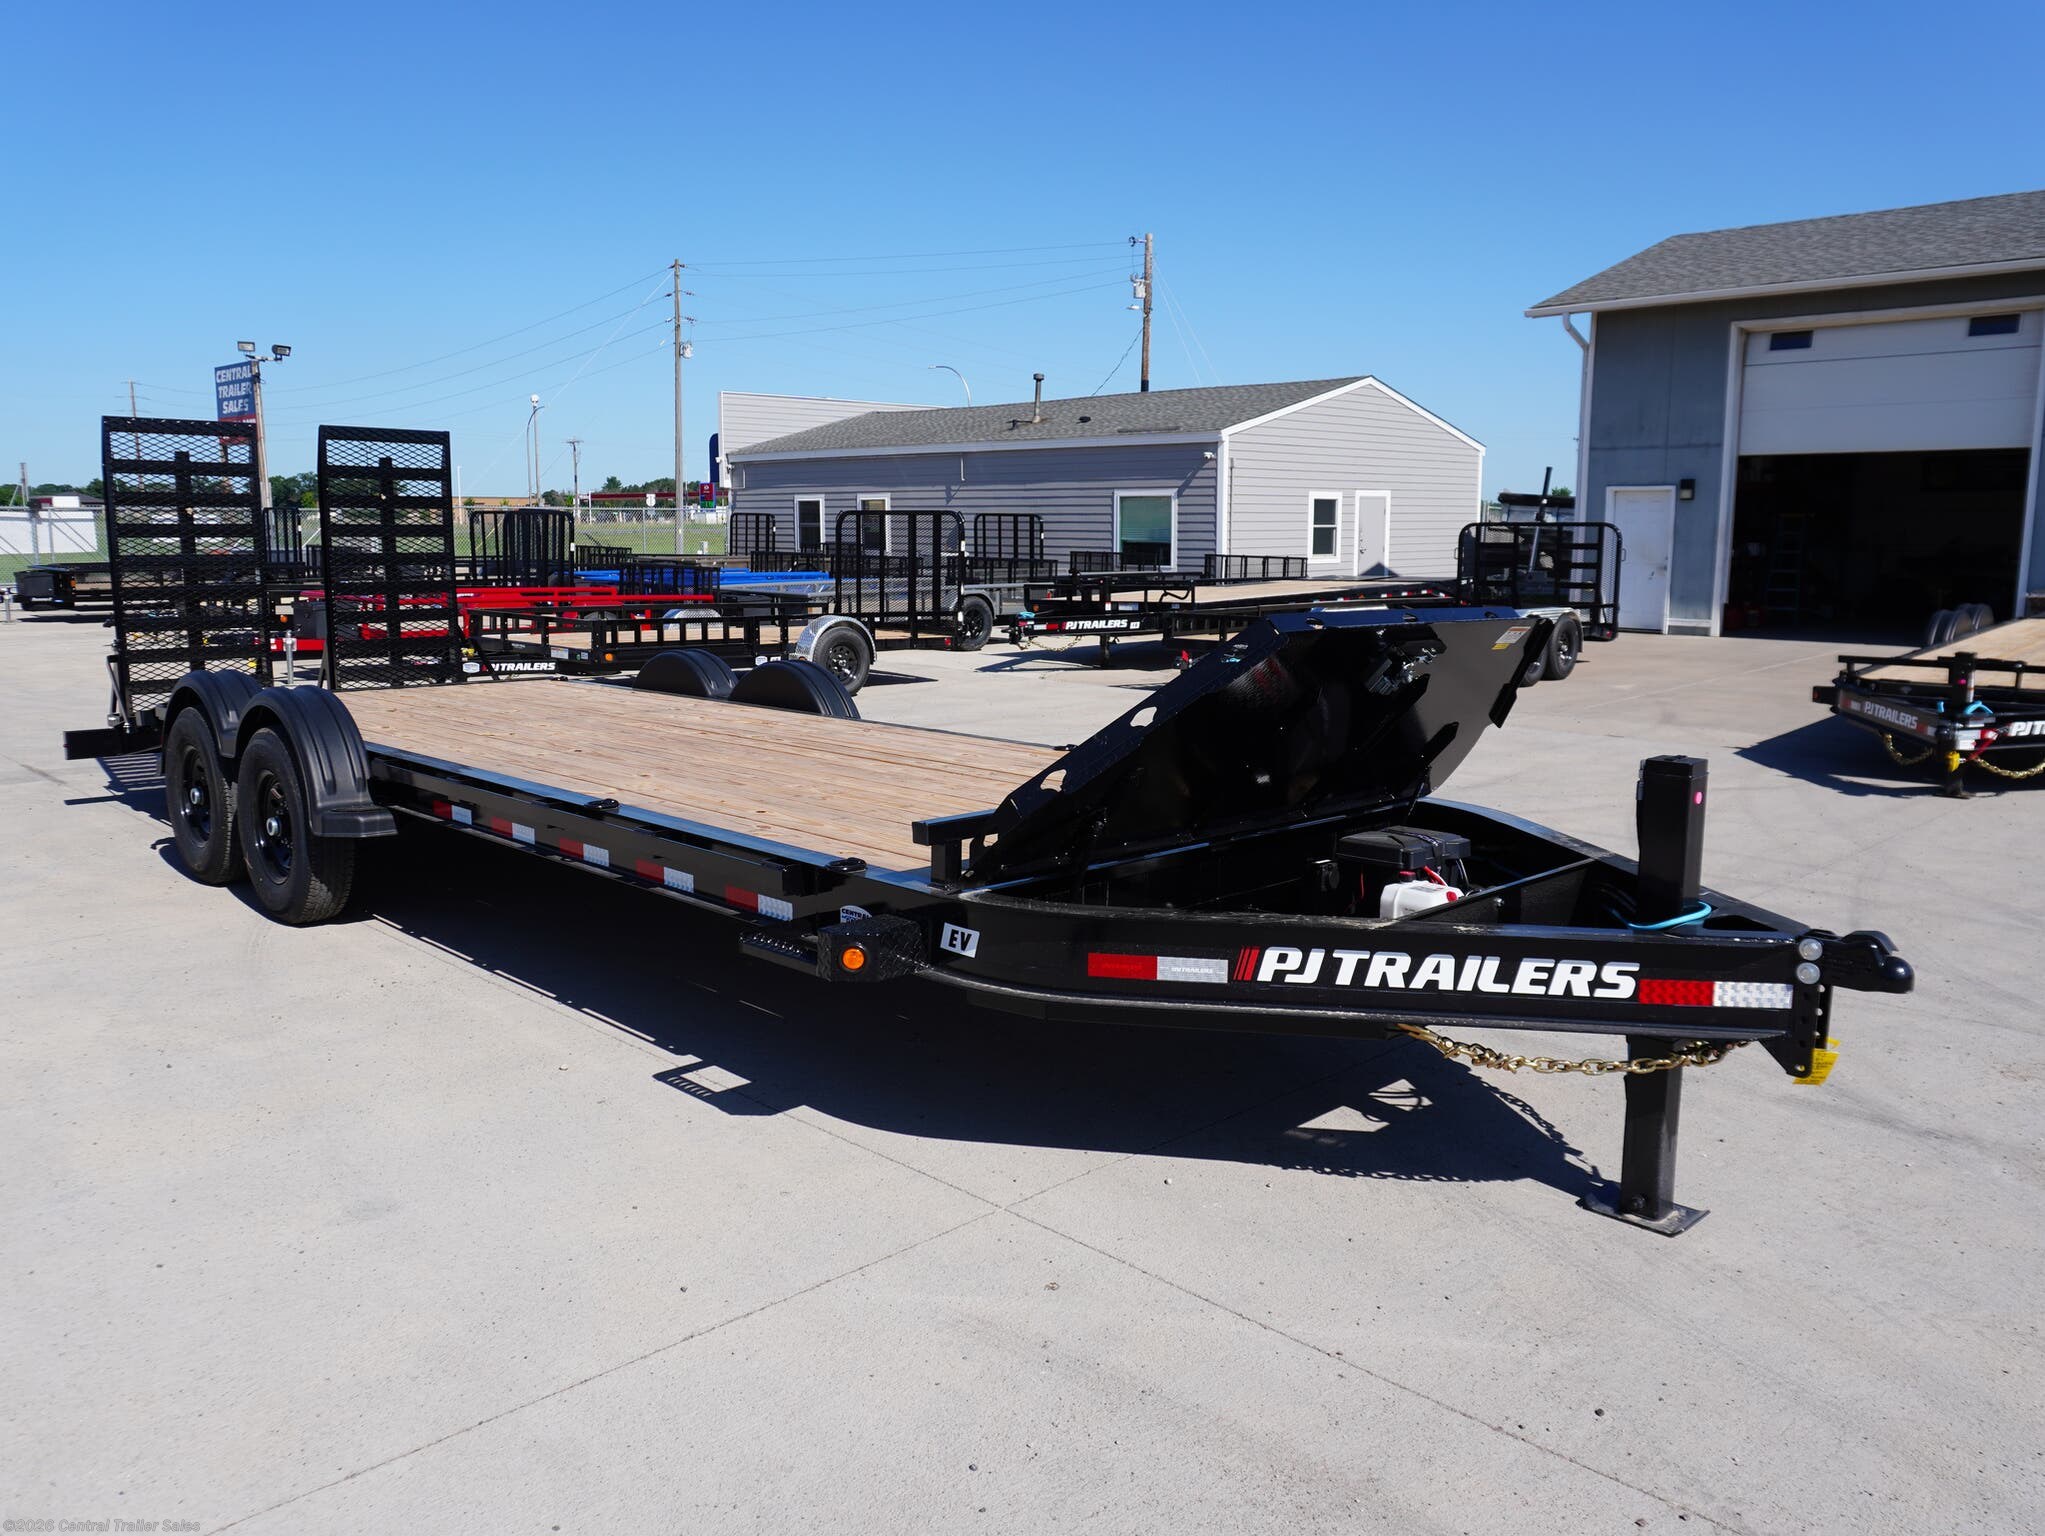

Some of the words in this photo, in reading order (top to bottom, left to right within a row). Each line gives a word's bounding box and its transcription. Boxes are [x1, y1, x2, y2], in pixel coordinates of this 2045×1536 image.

[216, 365, 252, 383] CENTRAL
[218, 382, 252, 399] TRAILER
[222, 399, 249, 414] SALES
[1065, 621, 1077, 630] PJ
[1078, 619, 1128, 629] TRAILERS
[500, 662, 556, 672] TRAILERS
[1864, 701, 1874, 715] PJ
[1874, 704, 1919, 730] TRAILERS
[948, 928, 972, 951] EV
[1256, 946, 1326, 983] PJ
[1332, 949, 1640, 999] TRAILERS
